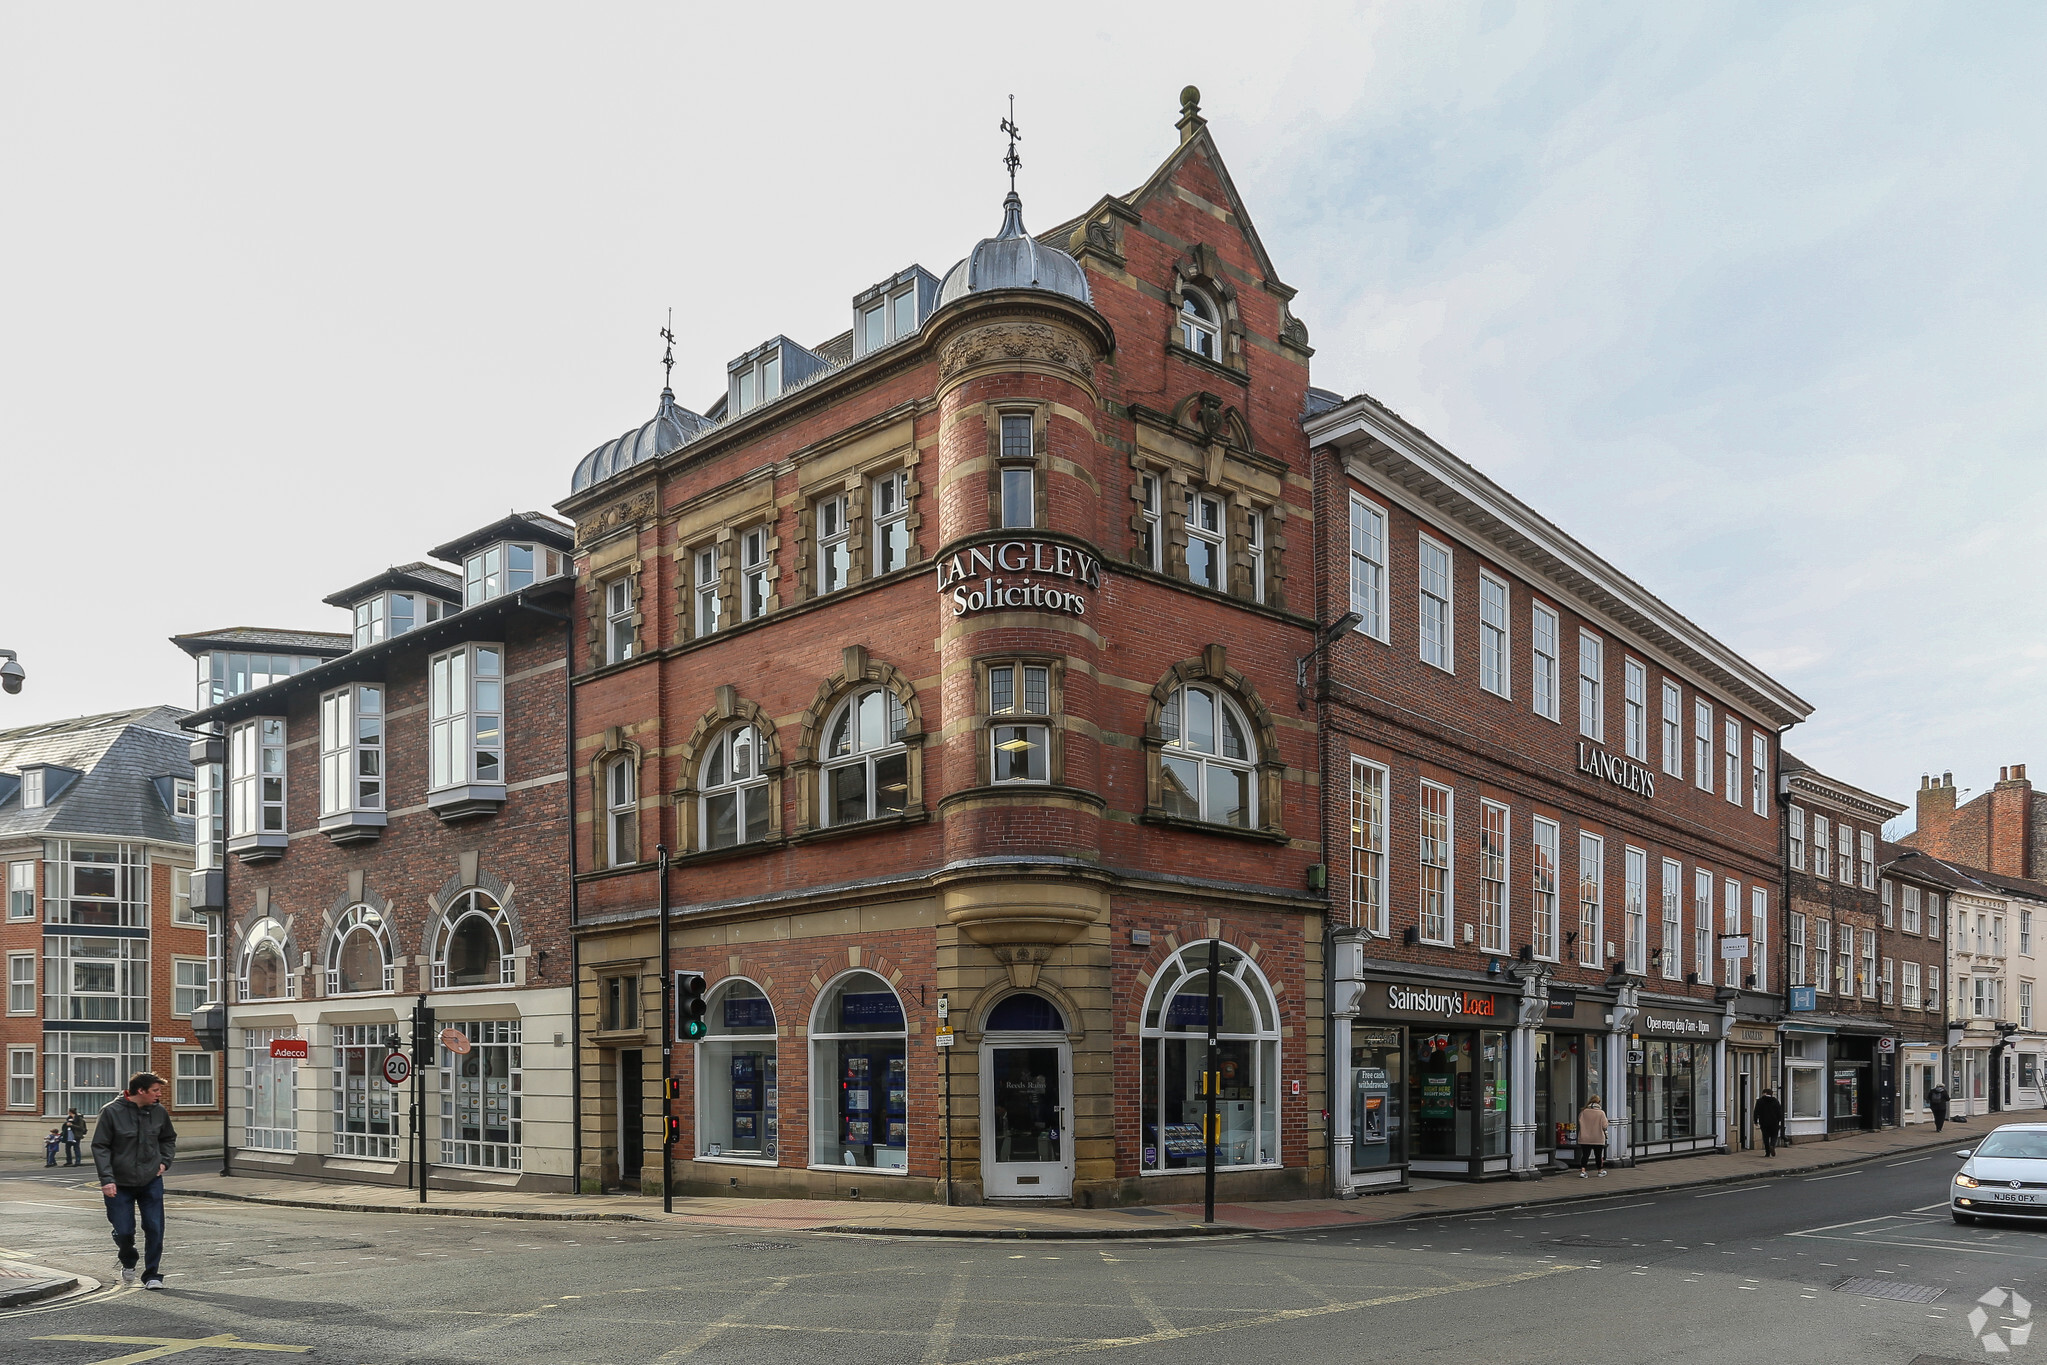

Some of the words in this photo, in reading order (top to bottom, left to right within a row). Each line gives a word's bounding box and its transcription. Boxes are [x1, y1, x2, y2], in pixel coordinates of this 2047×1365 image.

[936, 541, 1101, 593] LANGLEYS
[953, 577, 1085, 616] Solicitors
[1579, 742, 1655, 799] LANGLEYS
[1389, 985, 1462, 1018] Sainsbury's
[1463, 992, 1495, 1016] Local
[1647, 1015, 1661, 1032] Open
[1662, 1020, 1675, 1033] every
[1676, 1018, 1685, 1034] day
[1685, 1019, 1696, 1031] 7am
[1698, 1020, 1710, 1035] 11pm
[1741, 1029, 1763, 1041] LANGLEYS
[274, 1048, 306, 1057] Adecco
[388, 1061, 407, 1075] 20
[1362, 1070, 1373, 1079] Free
[1374, 1070, 1385, 1079] cash
[1358, 1080, 1389, 1089] withdrawals
[1994, 1193, 2016, 1201] NJ66
[2018, 1194, 2035, 1202] OFX
